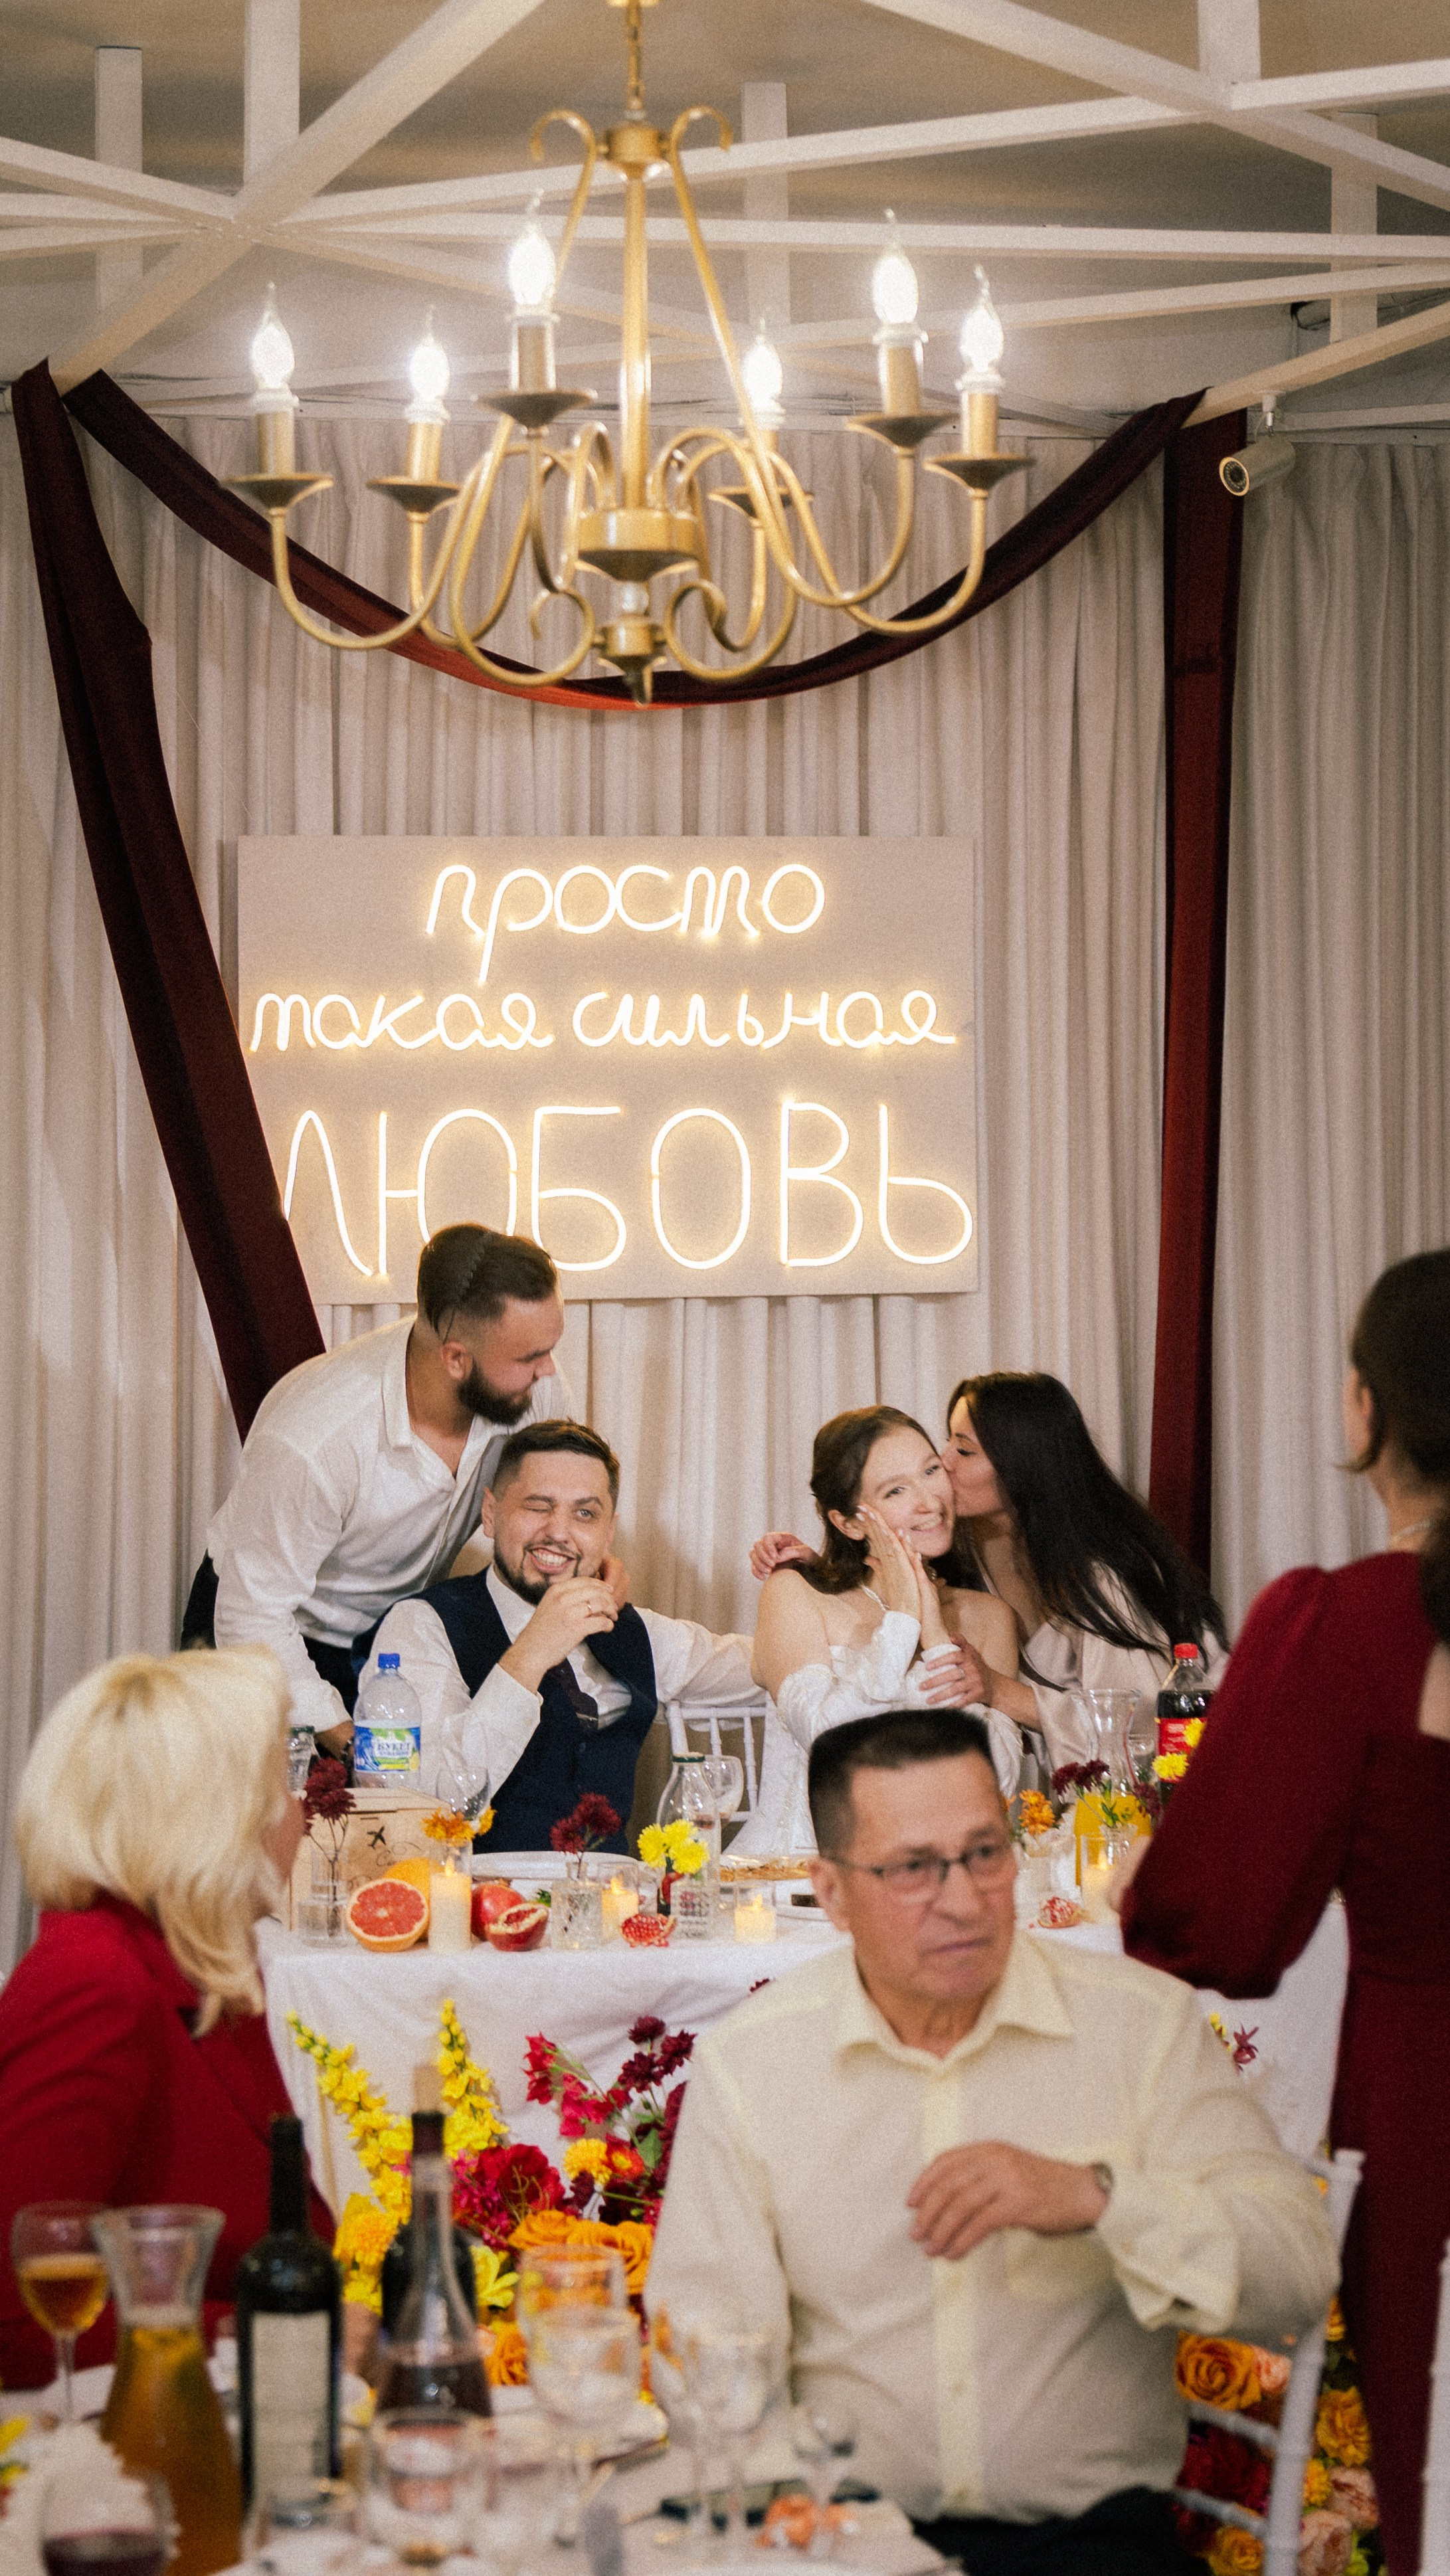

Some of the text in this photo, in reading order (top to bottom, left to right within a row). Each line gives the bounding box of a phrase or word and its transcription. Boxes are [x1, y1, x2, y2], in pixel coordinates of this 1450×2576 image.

[426, 864, 826, 983] просто
[250, 990, 956, 1052] такая сильная
[283, 1099, 972, 1275] ЛЮБОВЬ
